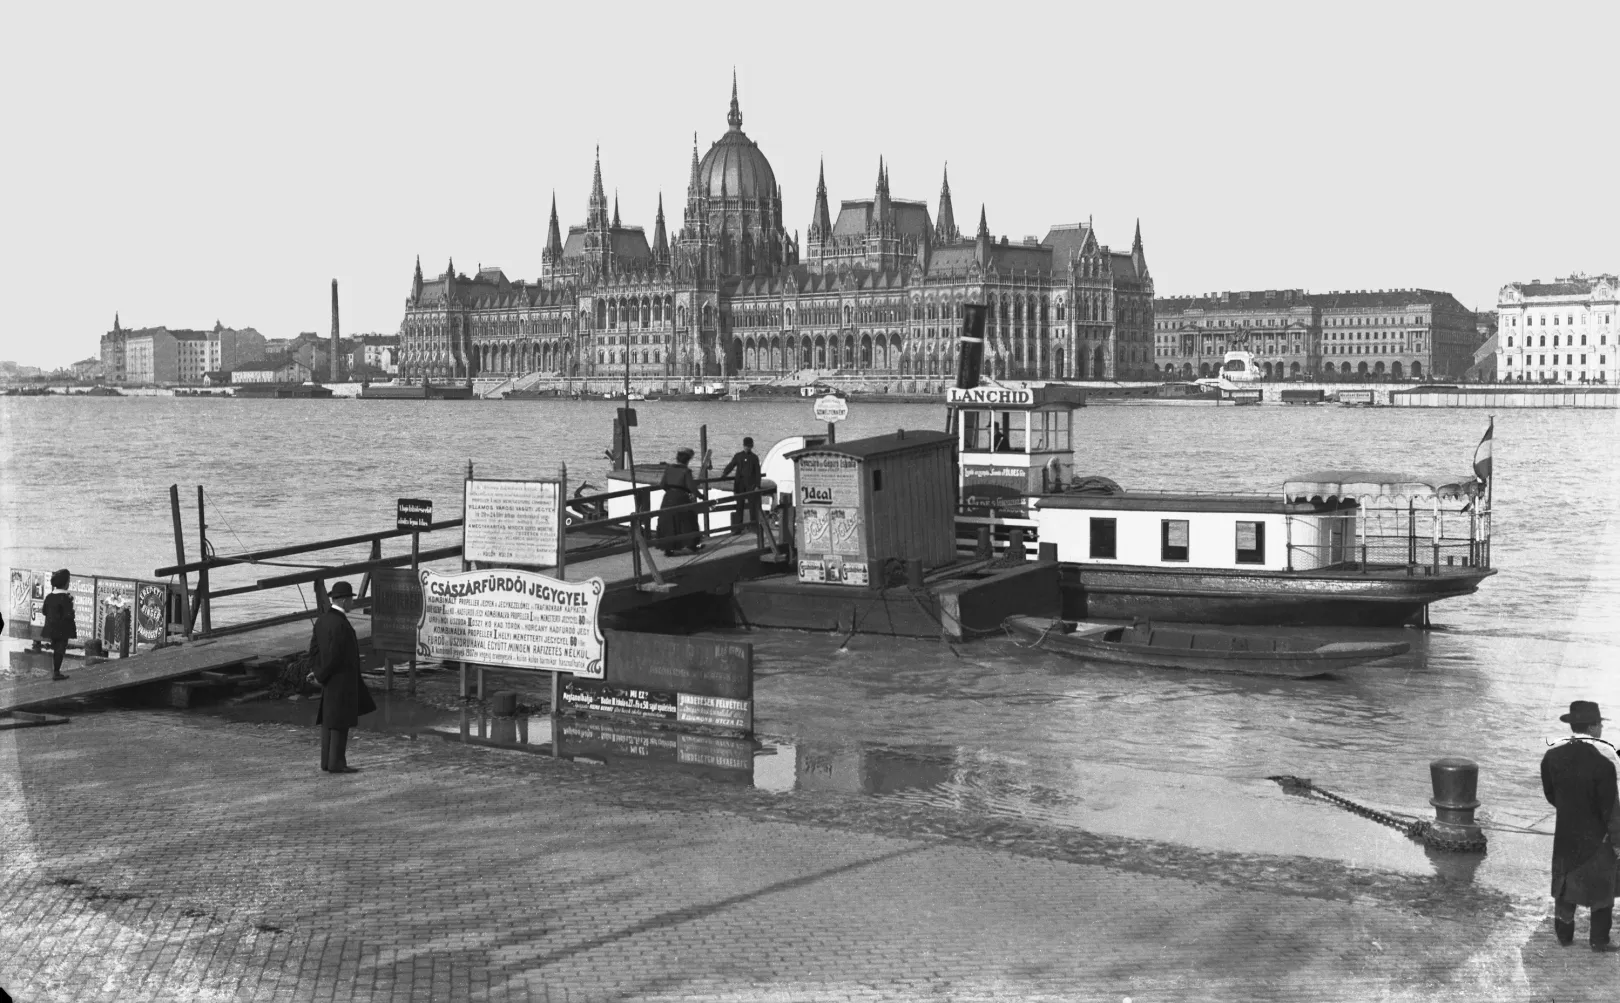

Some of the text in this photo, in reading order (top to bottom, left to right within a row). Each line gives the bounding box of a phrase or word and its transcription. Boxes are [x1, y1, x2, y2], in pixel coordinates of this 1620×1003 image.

[801, 486, 833, 502] Ideal
[431, 575, 588, 606] CSÁSZÁRFÜRDŐI JEGYGYEL
[141, 604, 162, 622] SINGER
[467, 629, 492, 638] PROPELLER
[498, 632, 512, 640] HELYI
[544, 636, 569, 645] JEGYGYEL
[508, 643, 531, 653] MINDEN
